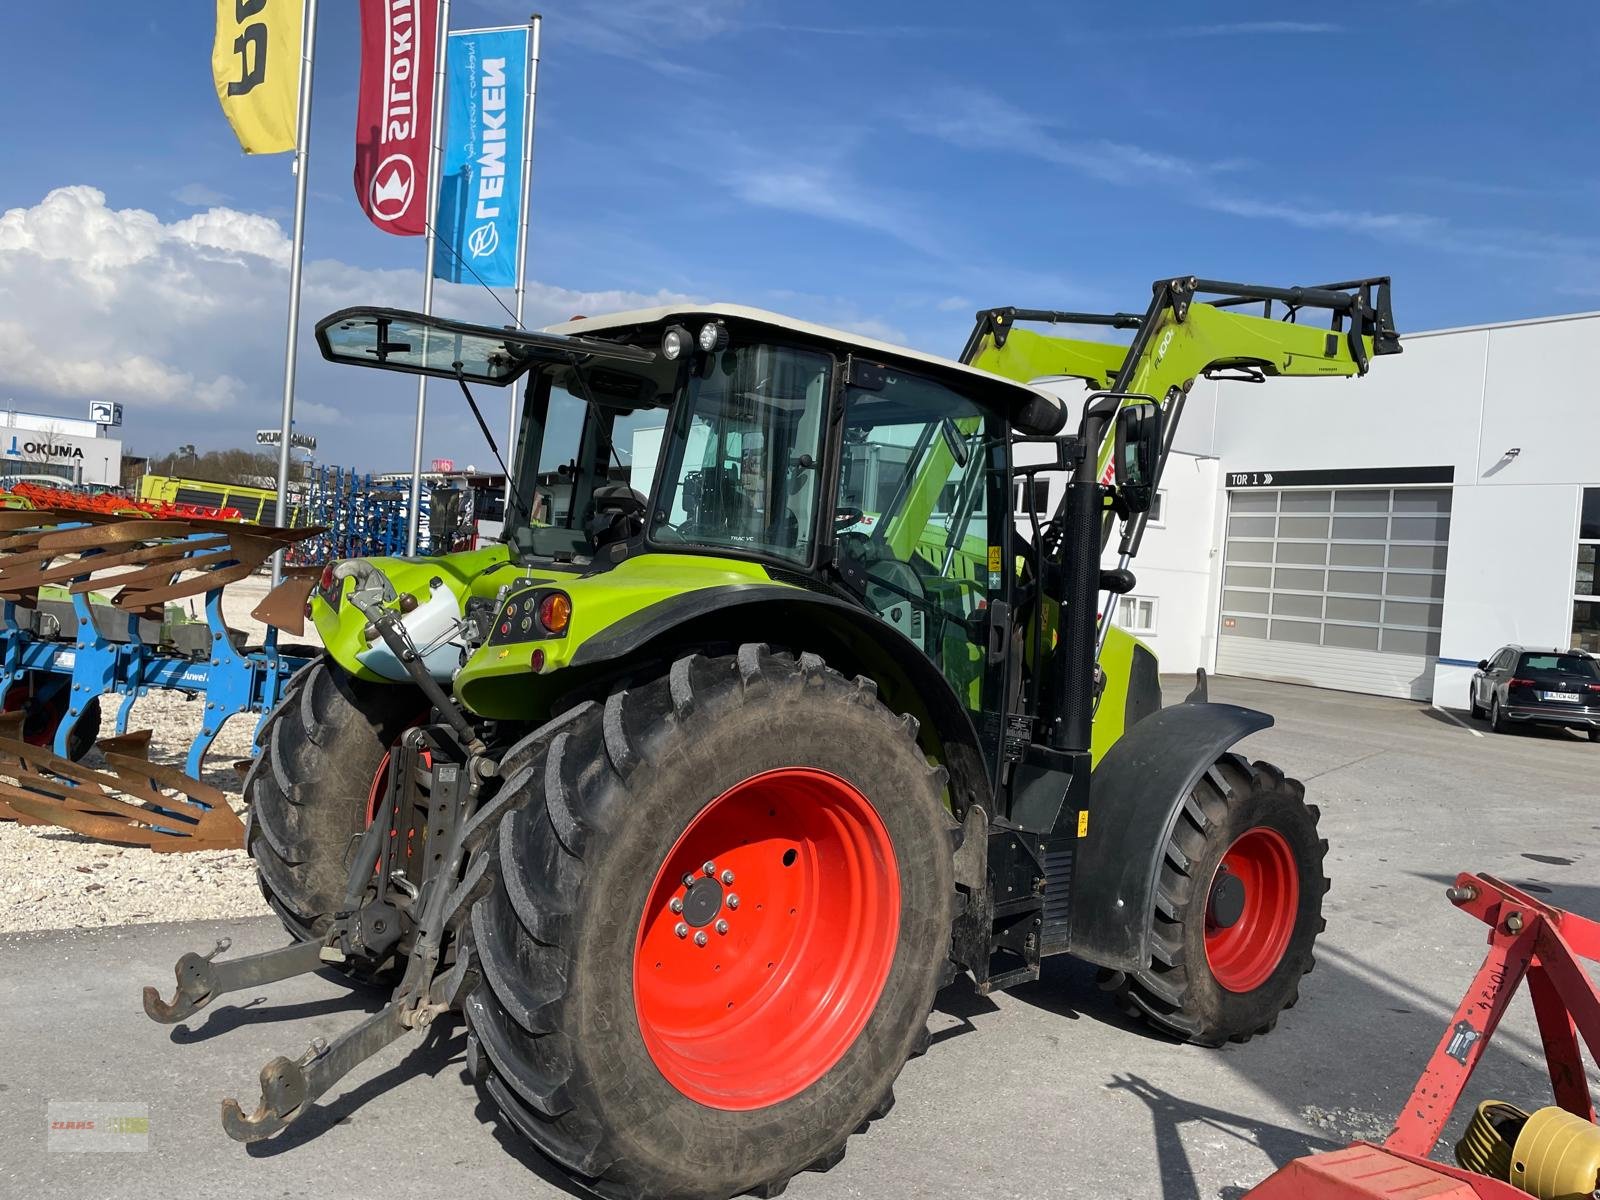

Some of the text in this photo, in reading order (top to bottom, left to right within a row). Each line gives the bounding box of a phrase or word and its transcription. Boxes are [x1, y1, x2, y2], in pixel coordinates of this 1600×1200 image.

[256, 432, 282, 443] OKUM
[23, 442, 84, 459] OKUMA
[1231, 473, 1259, 485] TOR 1
[182, 671, 207, 682] Juwel
